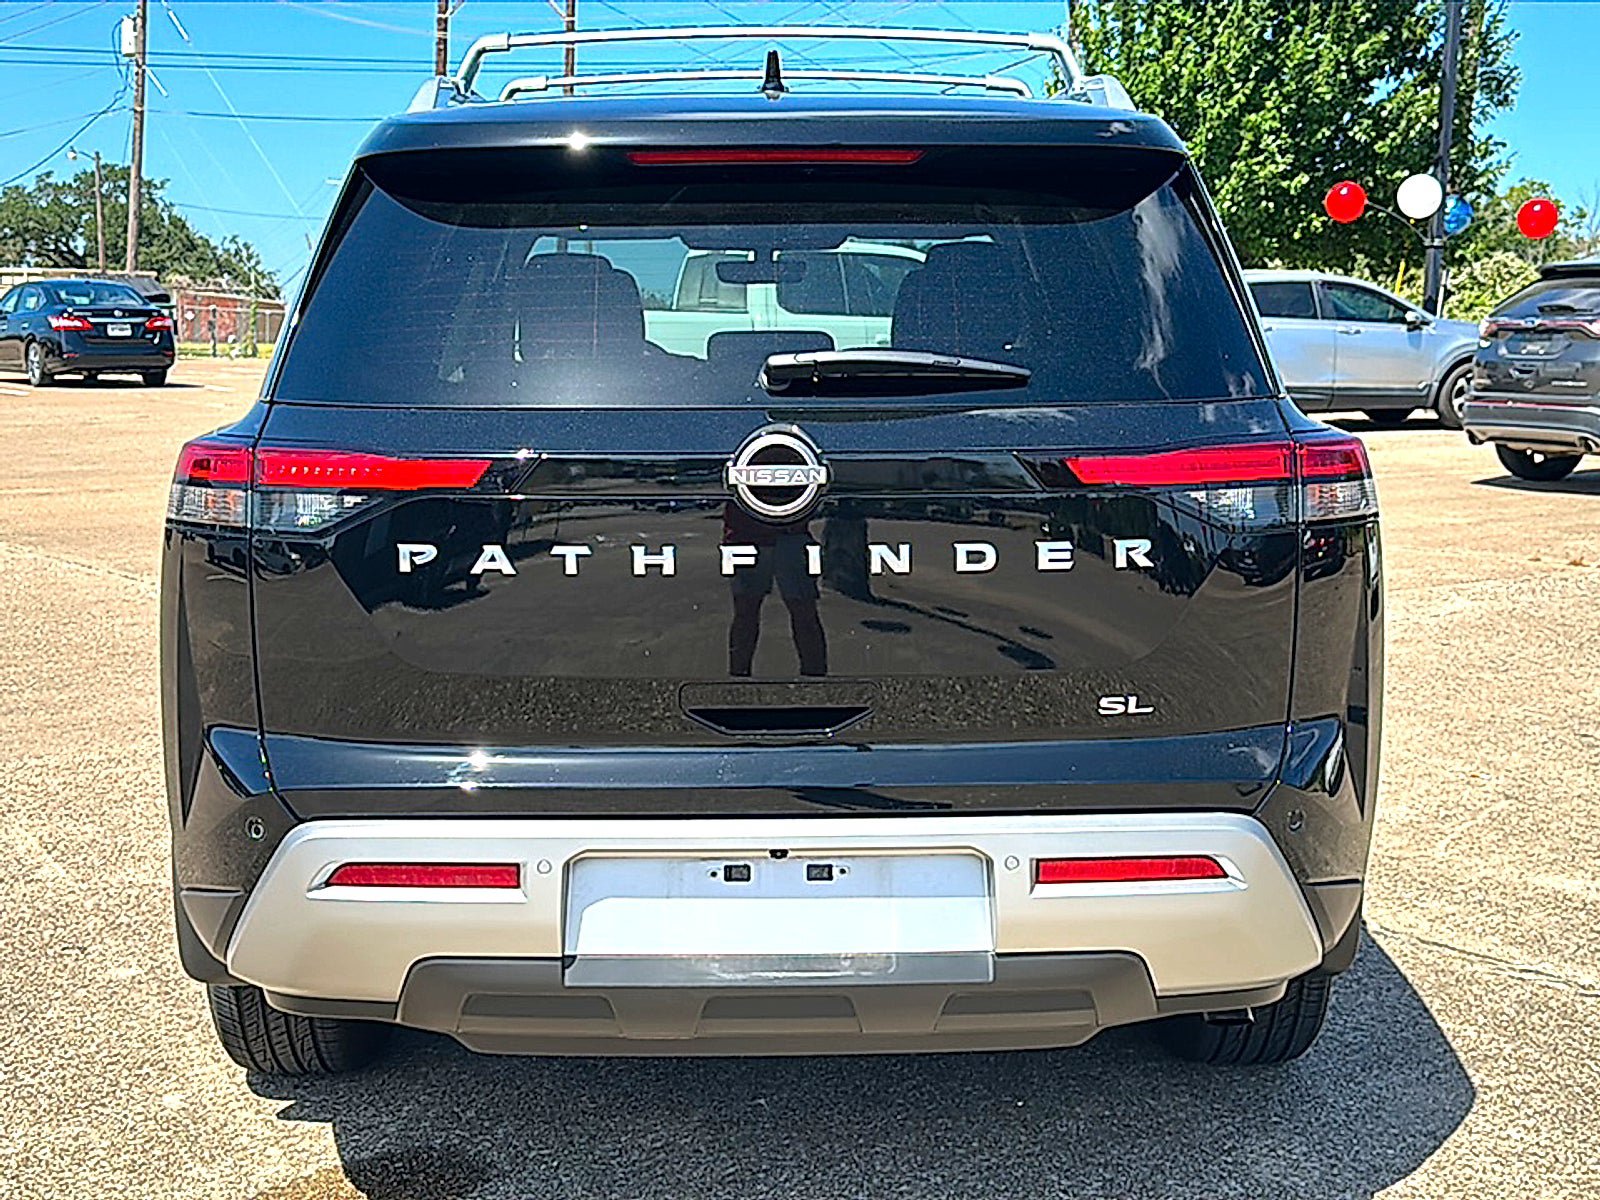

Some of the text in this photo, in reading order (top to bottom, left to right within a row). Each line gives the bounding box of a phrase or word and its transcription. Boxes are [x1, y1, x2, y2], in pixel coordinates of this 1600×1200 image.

[730, 467, 826, 484] NISSAN
[396, 538, 1155, 576] PATHFINDER
[1098, 695, 1154, 715] SL
